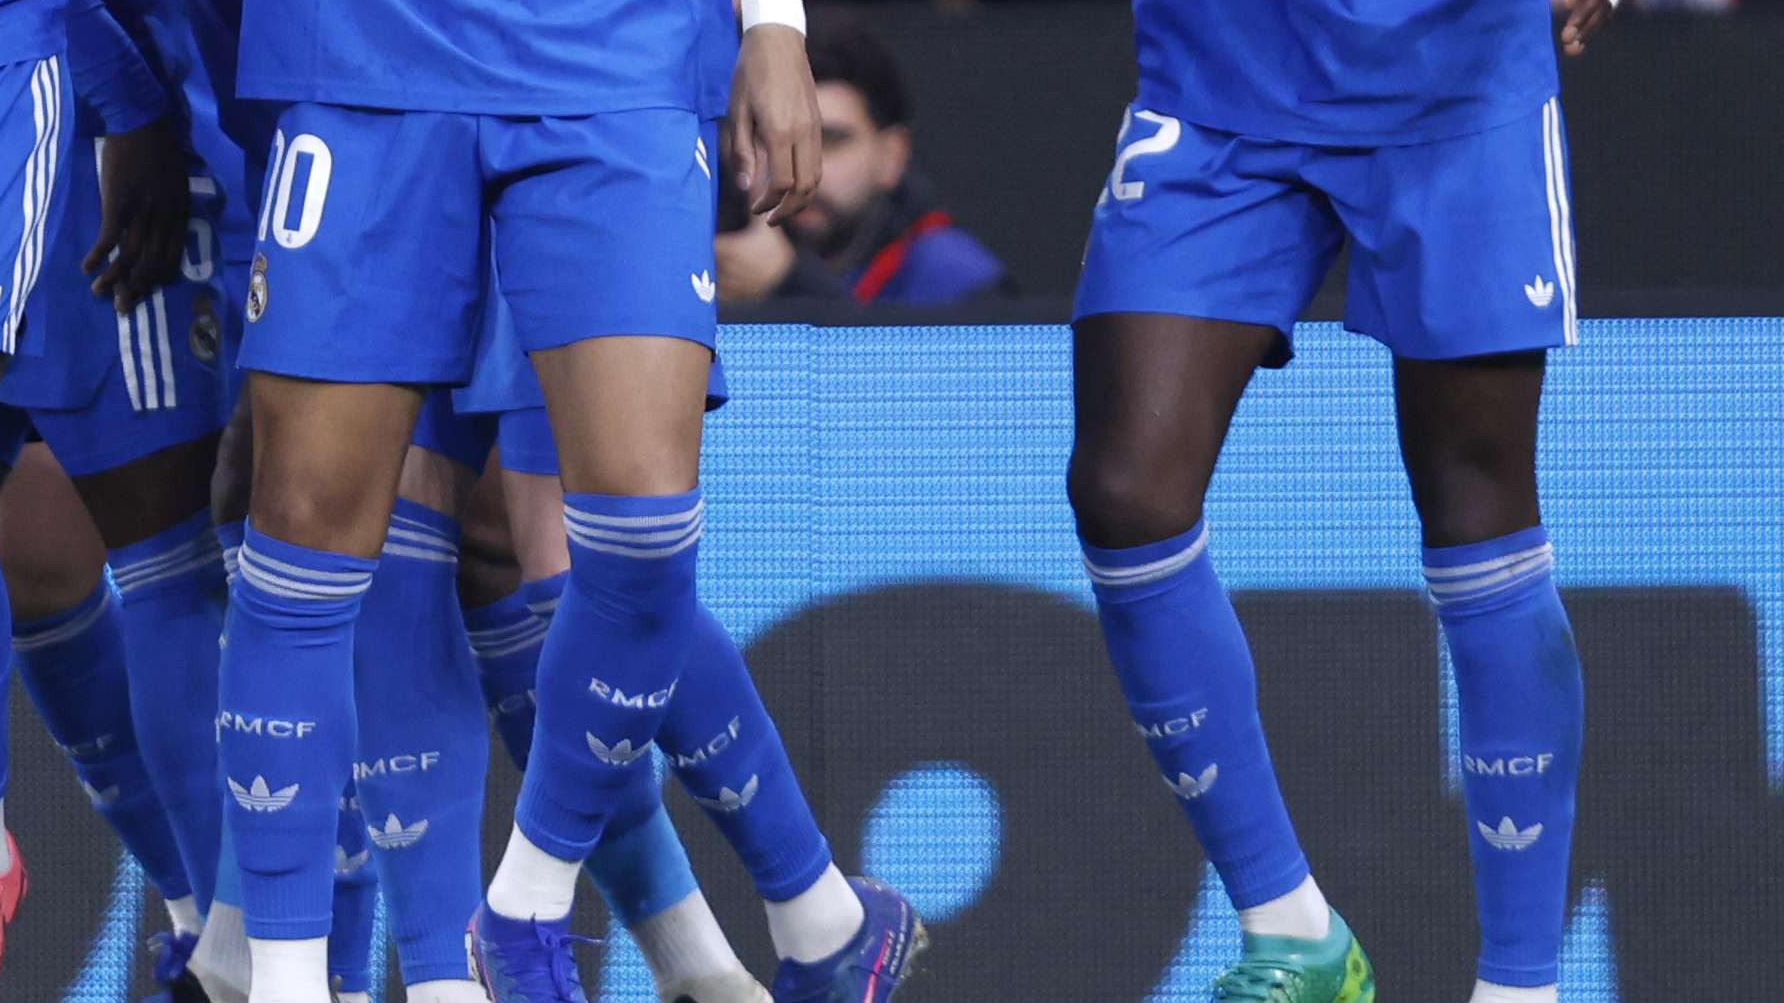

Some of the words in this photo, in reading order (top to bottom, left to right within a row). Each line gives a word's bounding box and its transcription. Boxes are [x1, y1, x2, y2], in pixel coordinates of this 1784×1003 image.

[1098, 106, 1181, 201] 2
[258, 128, 332, 249] 10
[219, 710, 316, 738] RMCF
[1133, 707, 1209, 740] MCF
